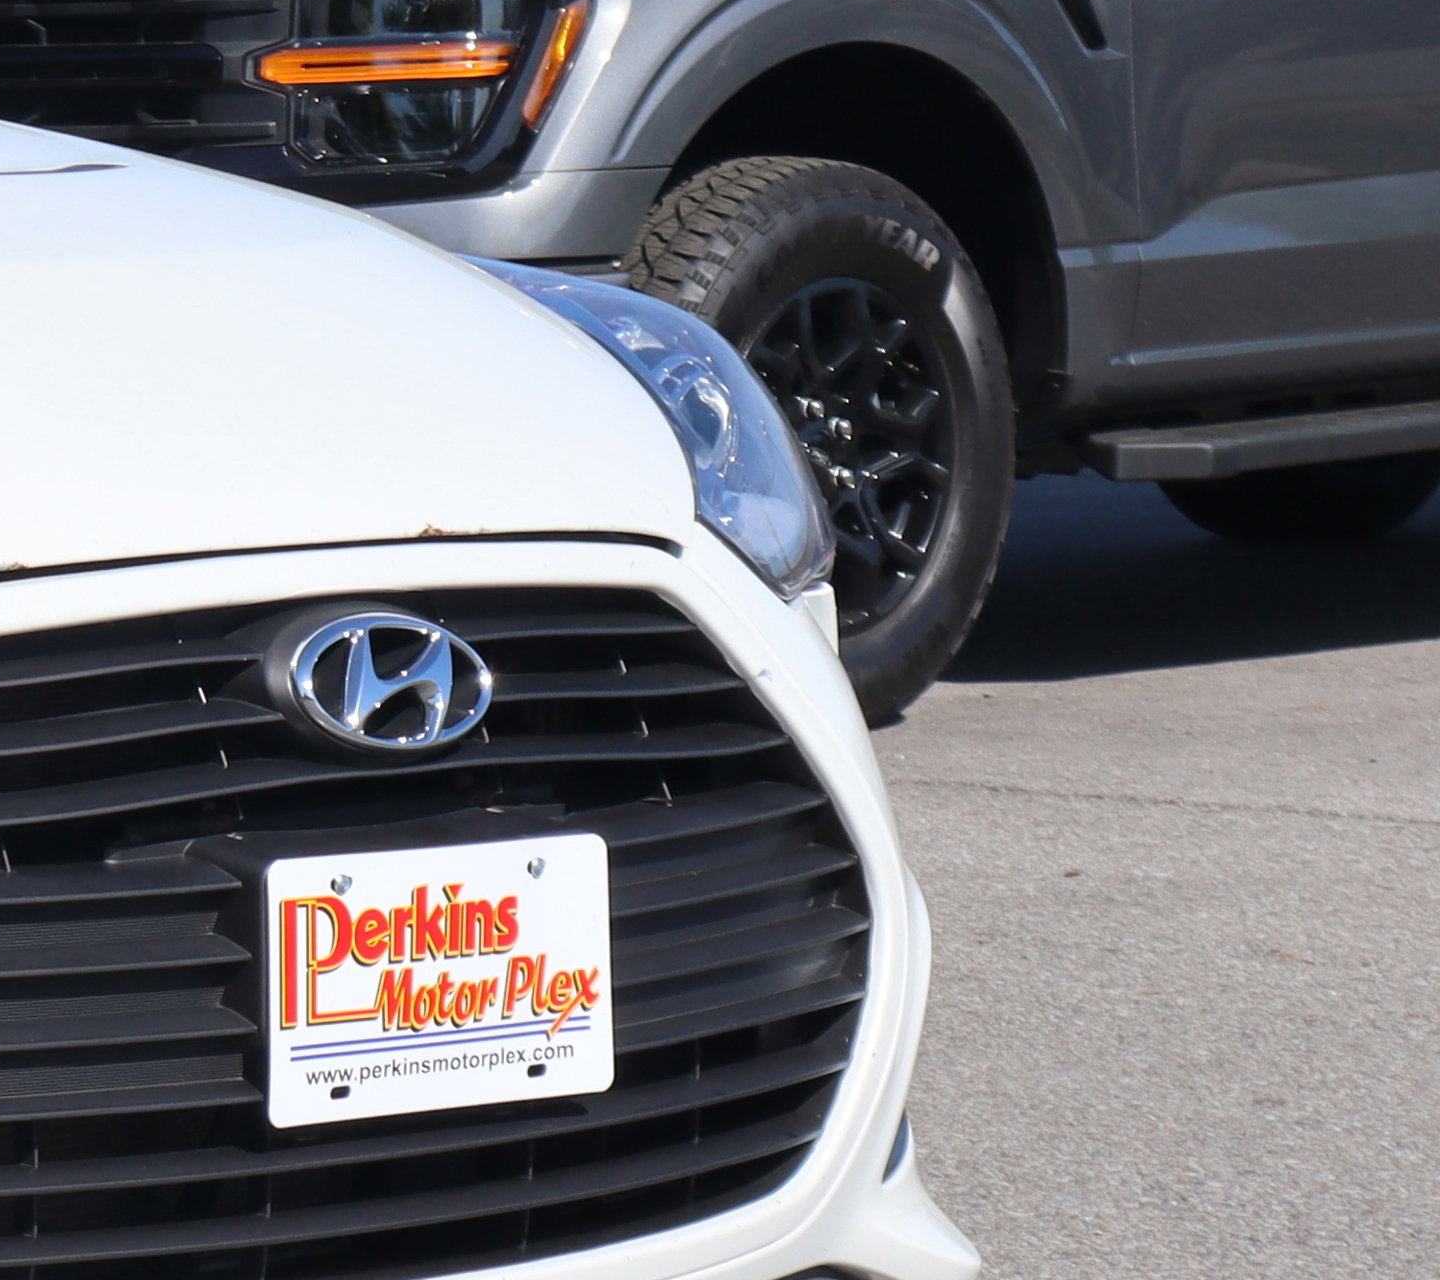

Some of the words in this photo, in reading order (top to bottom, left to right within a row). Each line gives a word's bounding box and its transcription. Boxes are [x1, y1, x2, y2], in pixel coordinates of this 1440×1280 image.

[280, 884, 520, 1029] Perkins
[377, 965, 499, 1030] Motor
[503, 953, 599, 1039] Plex
[305, 1043, 574, 1086] www.perkinsmotorplex.com
